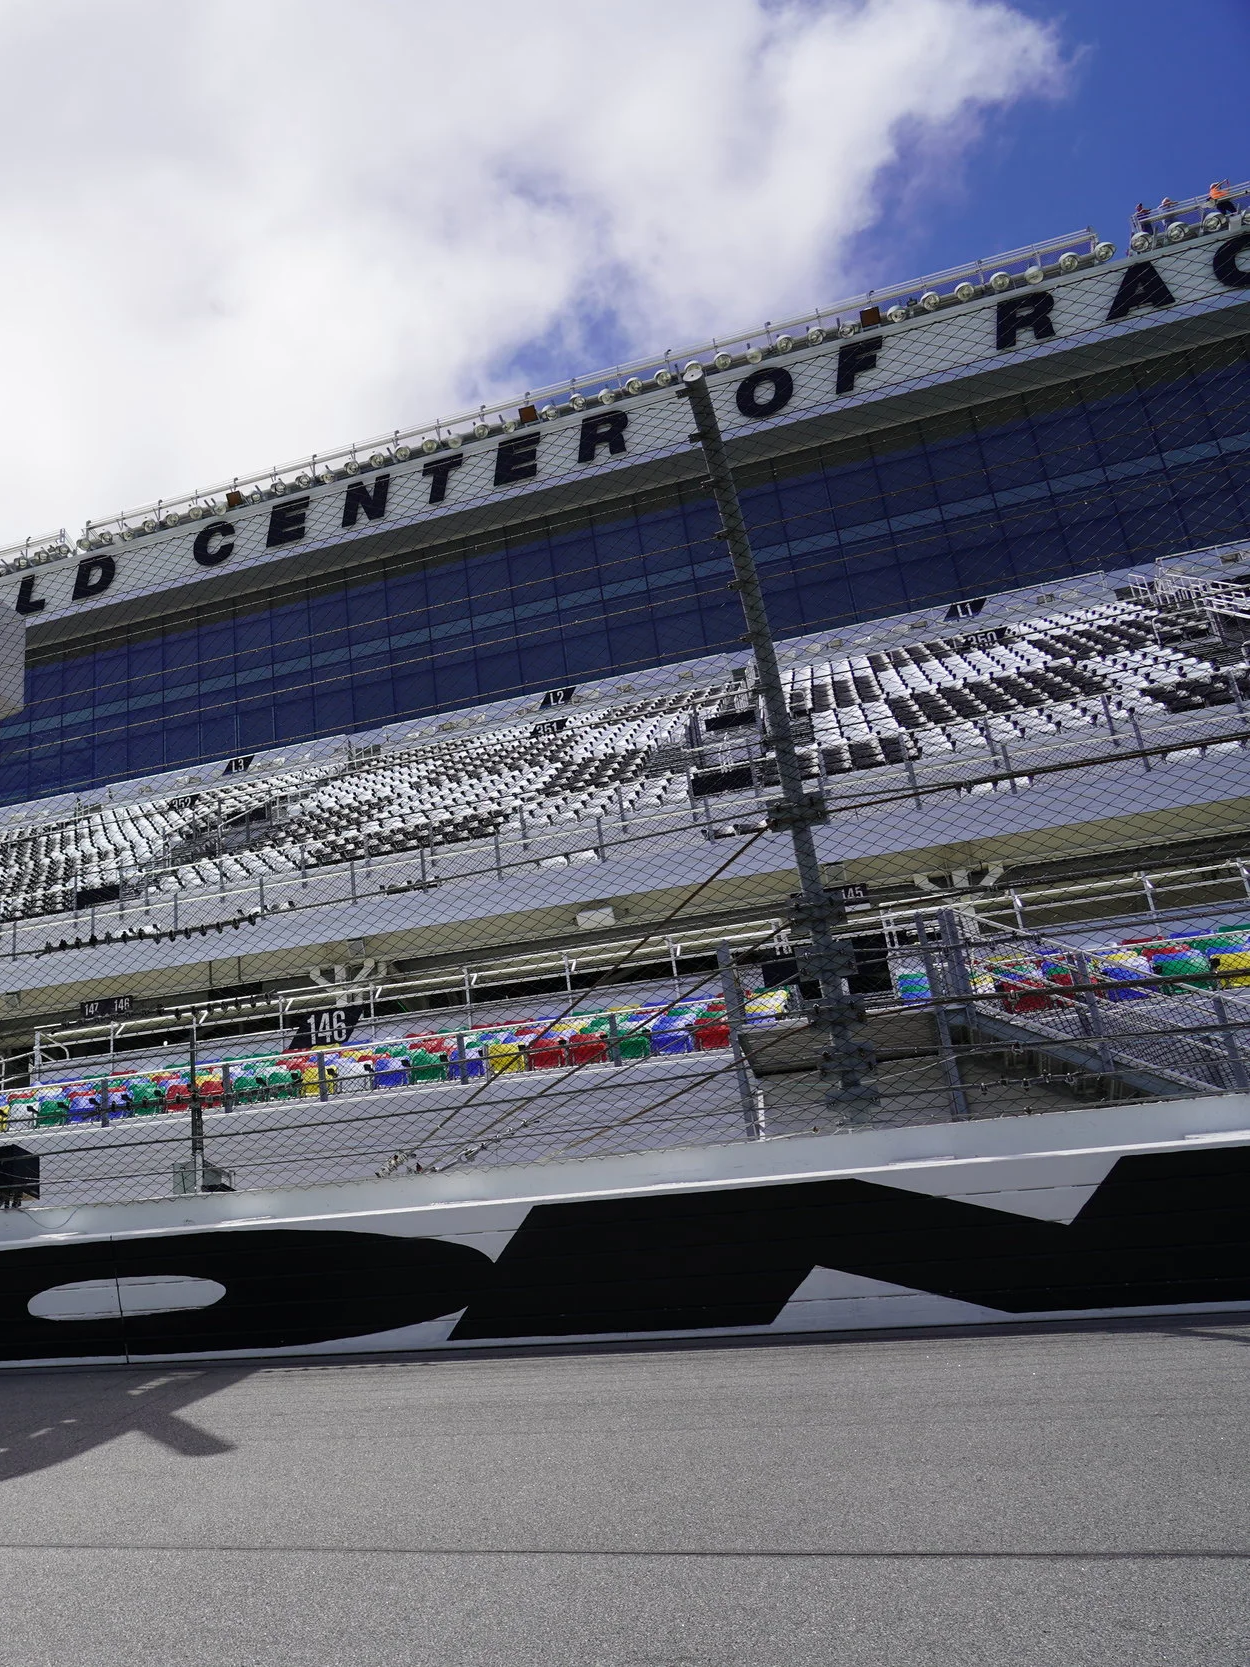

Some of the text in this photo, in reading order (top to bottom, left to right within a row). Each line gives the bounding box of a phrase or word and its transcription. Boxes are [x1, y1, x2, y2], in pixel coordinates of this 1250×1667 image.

[15, 553, 116, 615] LD
[193, 409, 628, 567] CENTER
[736, 335, 883, 418] OF
[956, 602, 973, 618] L1
[549, 690, 565, 706] L2
[231, 758, 245, 773] L3
[84, 1002, 99, 1016] 147
[306, 1010, 347, 1045] 146
